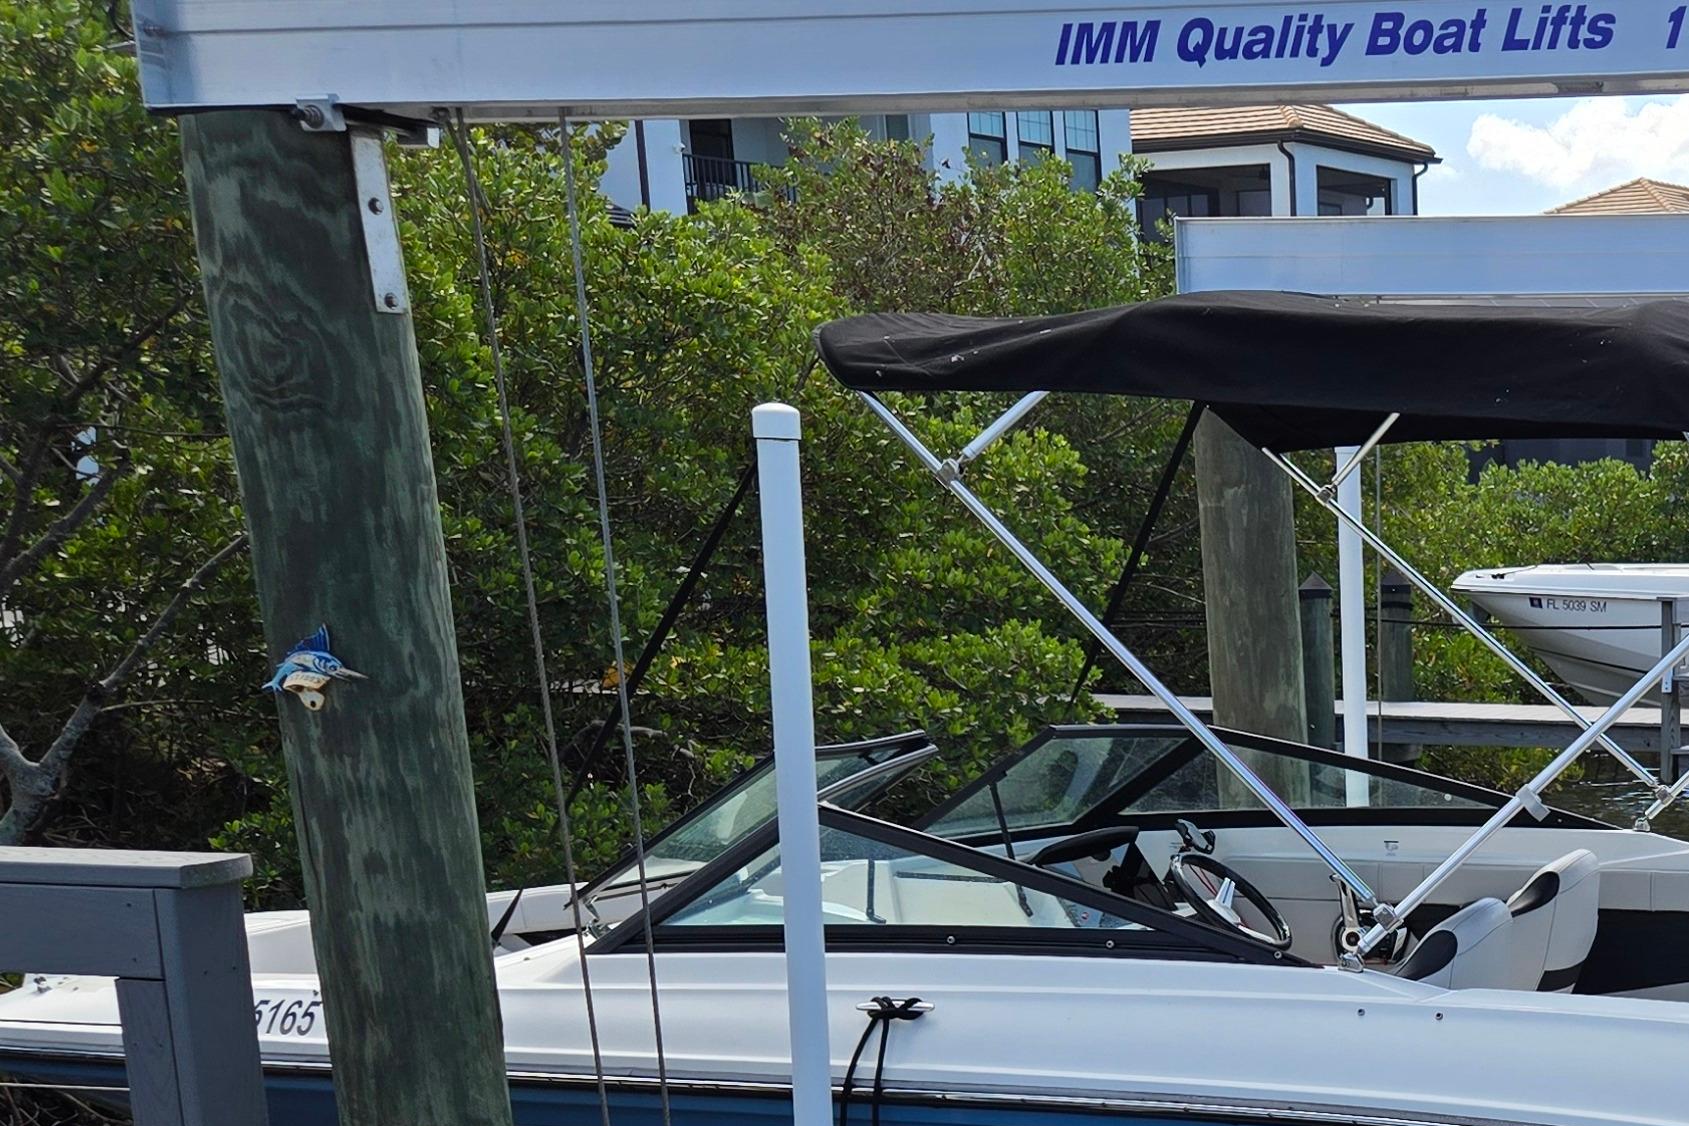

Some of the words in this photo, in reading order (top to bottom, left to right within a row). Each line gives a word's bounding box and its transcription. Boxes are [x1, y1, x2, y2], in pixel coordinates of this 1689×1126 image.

[1055, 20, 1161, 66] IMM
[1176, 14, 1354, 68] Quality
[1365, 8, 1486, 56] Boat
[1502, 4, 1617, 51] Lifts
[1546, 598, 1559, 610] FL
[1562, 599, 1587, 611] 5039
[1590, 600, 1607, 612] SM
